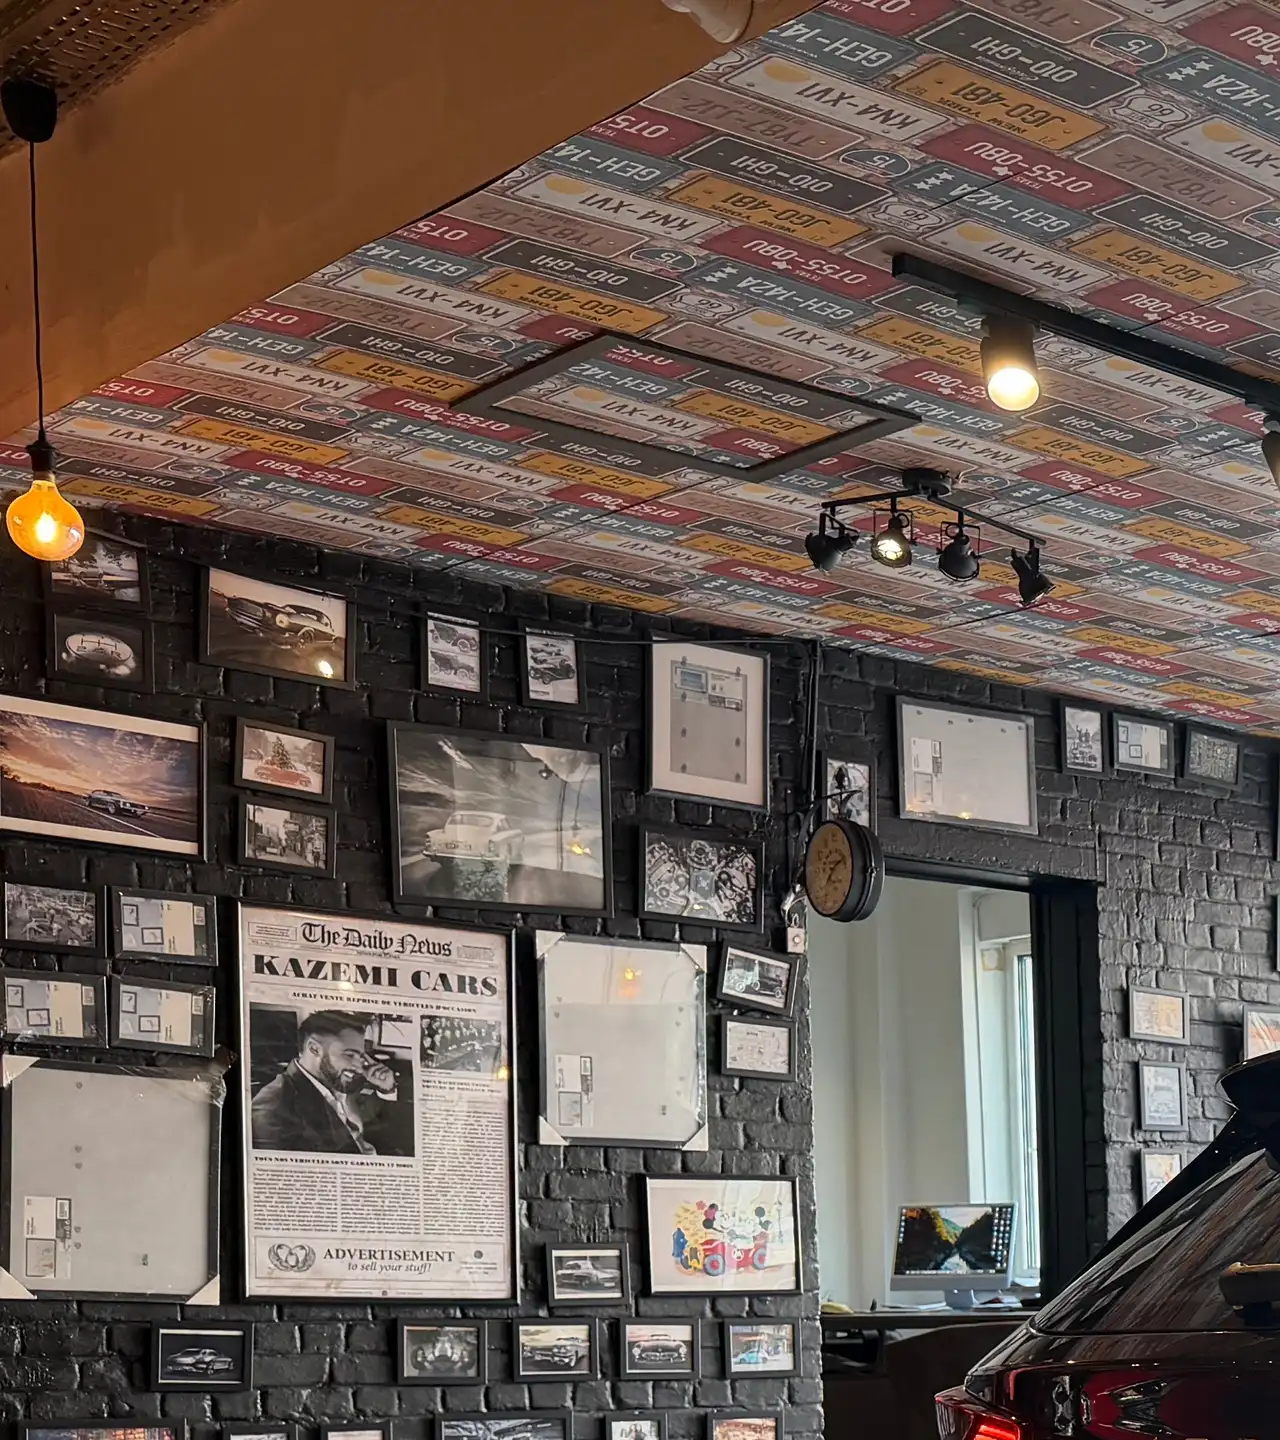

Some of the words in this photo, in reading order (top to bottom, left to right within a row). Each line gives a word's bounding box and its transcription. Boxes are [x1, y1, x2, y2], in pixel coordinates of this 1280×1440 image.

[1119, 37, 1152, 55] 15
[865, 153, 896, 169] 15
[949, 182, 1069, 232] GEH-142A
[654, 251, 682, 264] 15
[737, 276, 852, 318] GEH-142A
[834, 378, 859, 389] 15
[400, 423, 508, 455] GEH-142A
[264, 480, 369, 509] GEH-142A
[301, 922, 340, 948] The
[342, 926, 393, 951] Daily
[398, 933, 452, 957] News
[252, 954, 399, 988] KAZEMI
[410, 969, 498, 998] CARS
[323, 1248, 456, 1263] ADVERTISEMENT
[360, 1262, 377, 1272] sell
[379, 1264, 402, 1274] your
